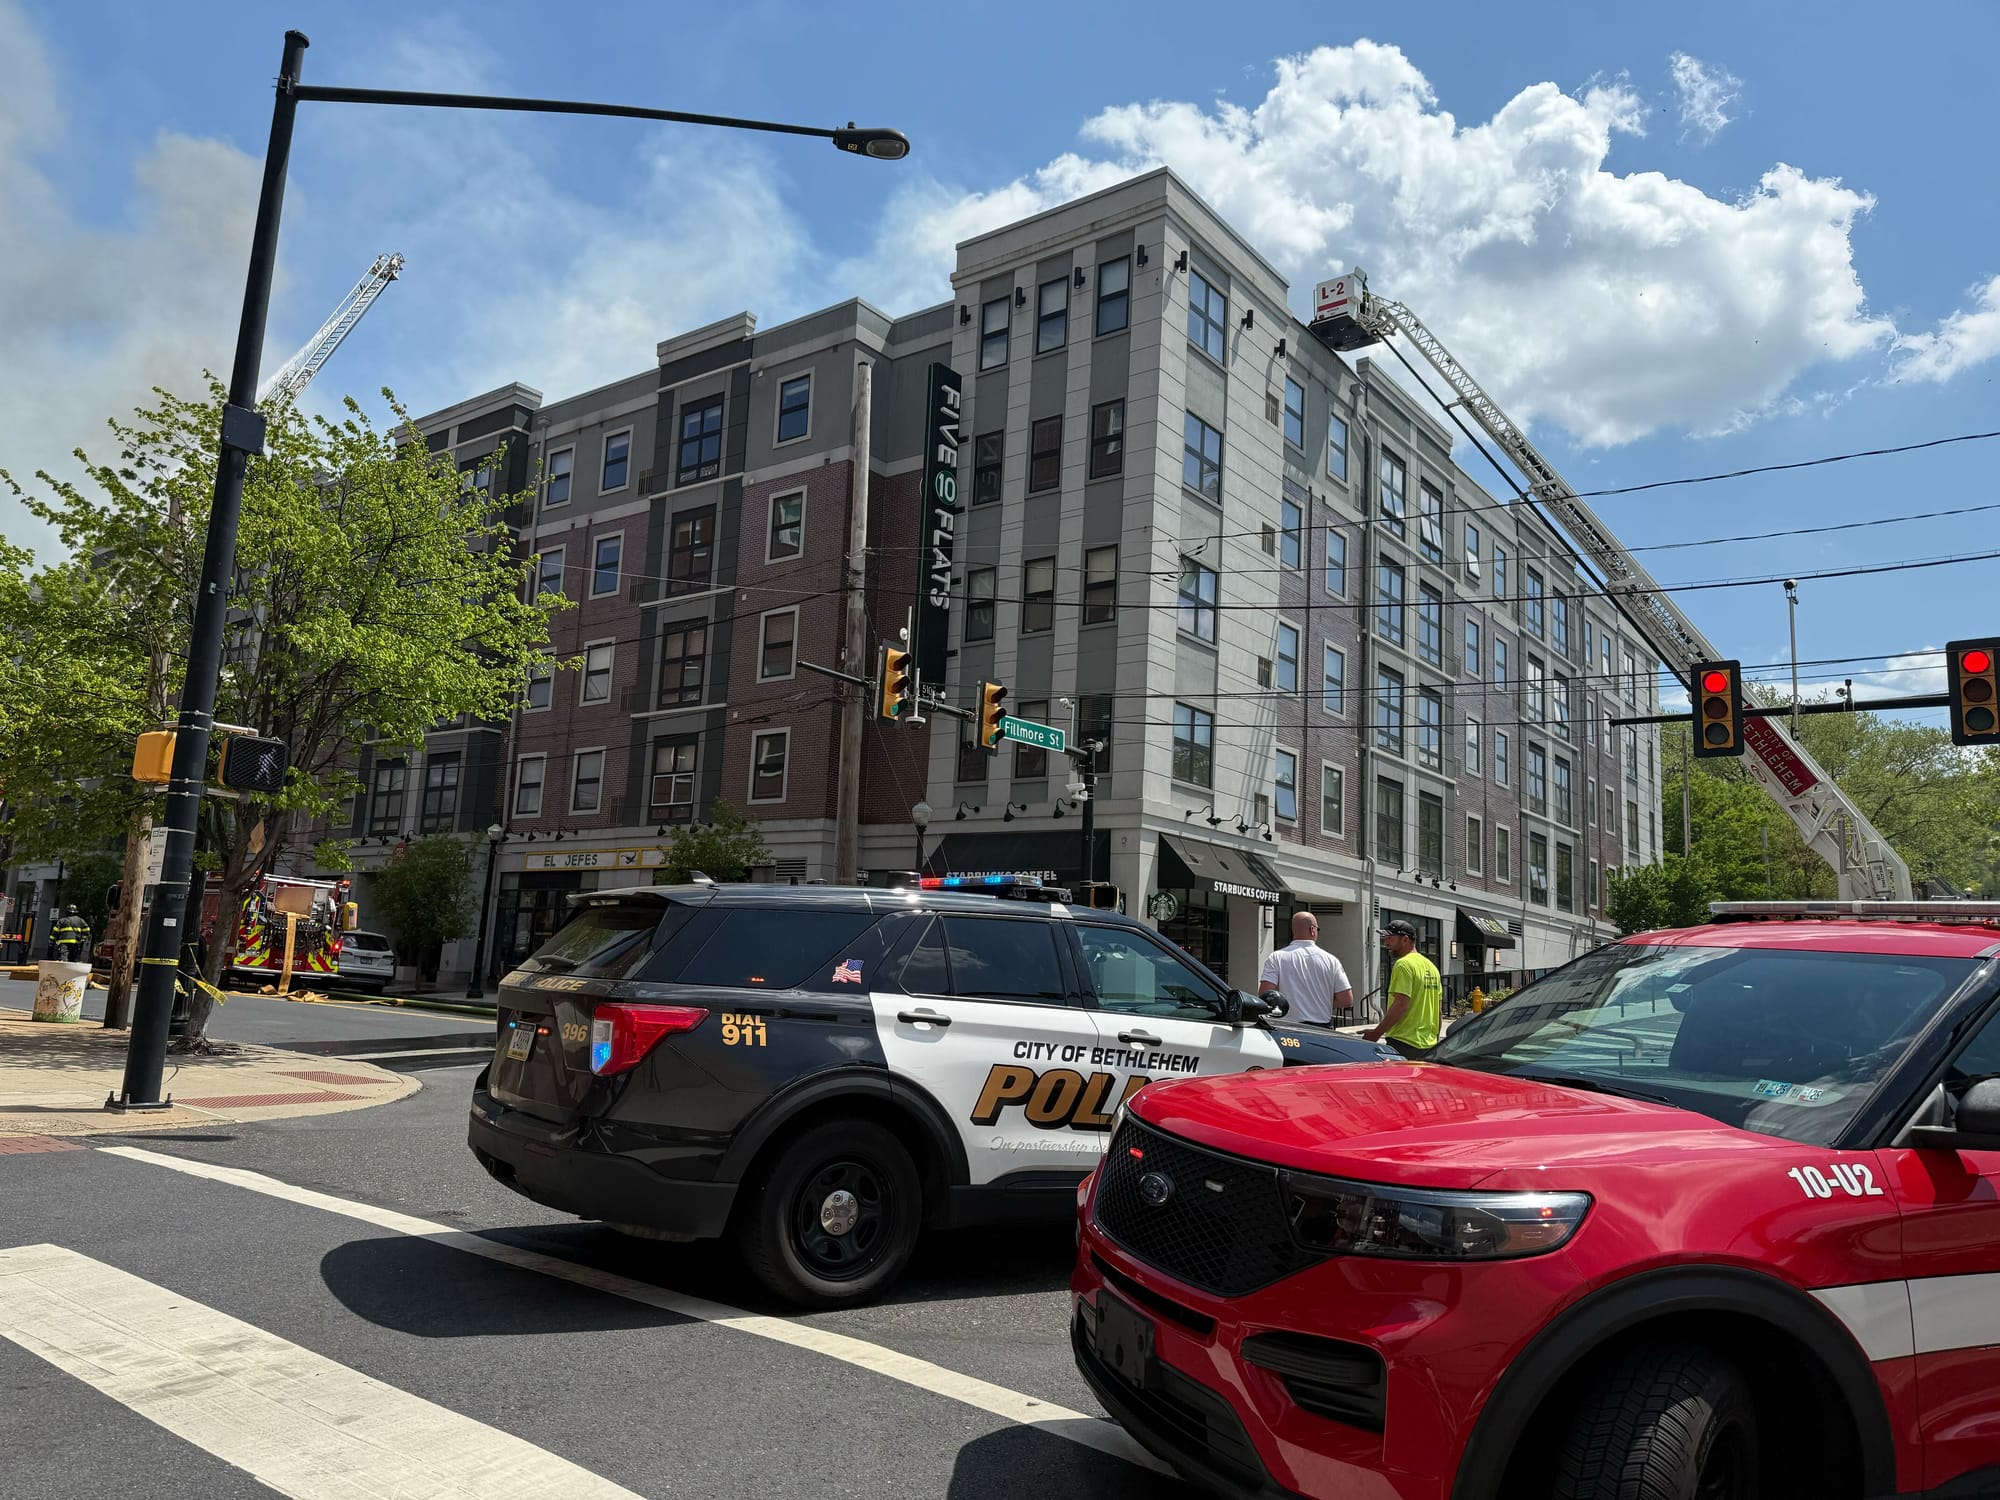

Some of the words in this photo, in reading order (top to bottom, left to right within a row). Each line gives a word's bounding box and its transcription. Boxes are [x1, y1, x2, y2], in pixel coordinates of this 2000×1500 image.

[1322, 281, 1345, 300] L-2
[938, 384, 960, 468] FIVE
[939, 473, 956, 502] 10
[930, 508, 954, 609] FLATS
[1004, 721, 1045, 743] Fillmore
[1049, 734, 1060, 747] St
[1764, 728, 1784, 749] CITY
[1782, 750, 1795, 762] OF
[1743, 719, 1804, 791] ETHLEHEM
[544, 855, 556, 867] EL
[565, 854, 598, 867] JEFES
[1214, 881, 1255, 898] STARBUCKS
[1255, 889, 1280, 903] COFFEE
[562, 1022, 589, 1042] 396
[721, 1012, 766, 1027] DIAL
[721, 1024, 767, 1047] 911
[1280, 1036, 1300, 1048] 396
[1013, 1040, 1060, 1060] CITY
[1061, 1044, 1087, 1063] OF
[1090, 1047, 1200, 1074] BETHLEHEM
[970, 1063, 1160, 1132] POL
[1012, 1138, 1087, 1157] partnership
[1787, 1163, 1884, 1199] 10-U2
